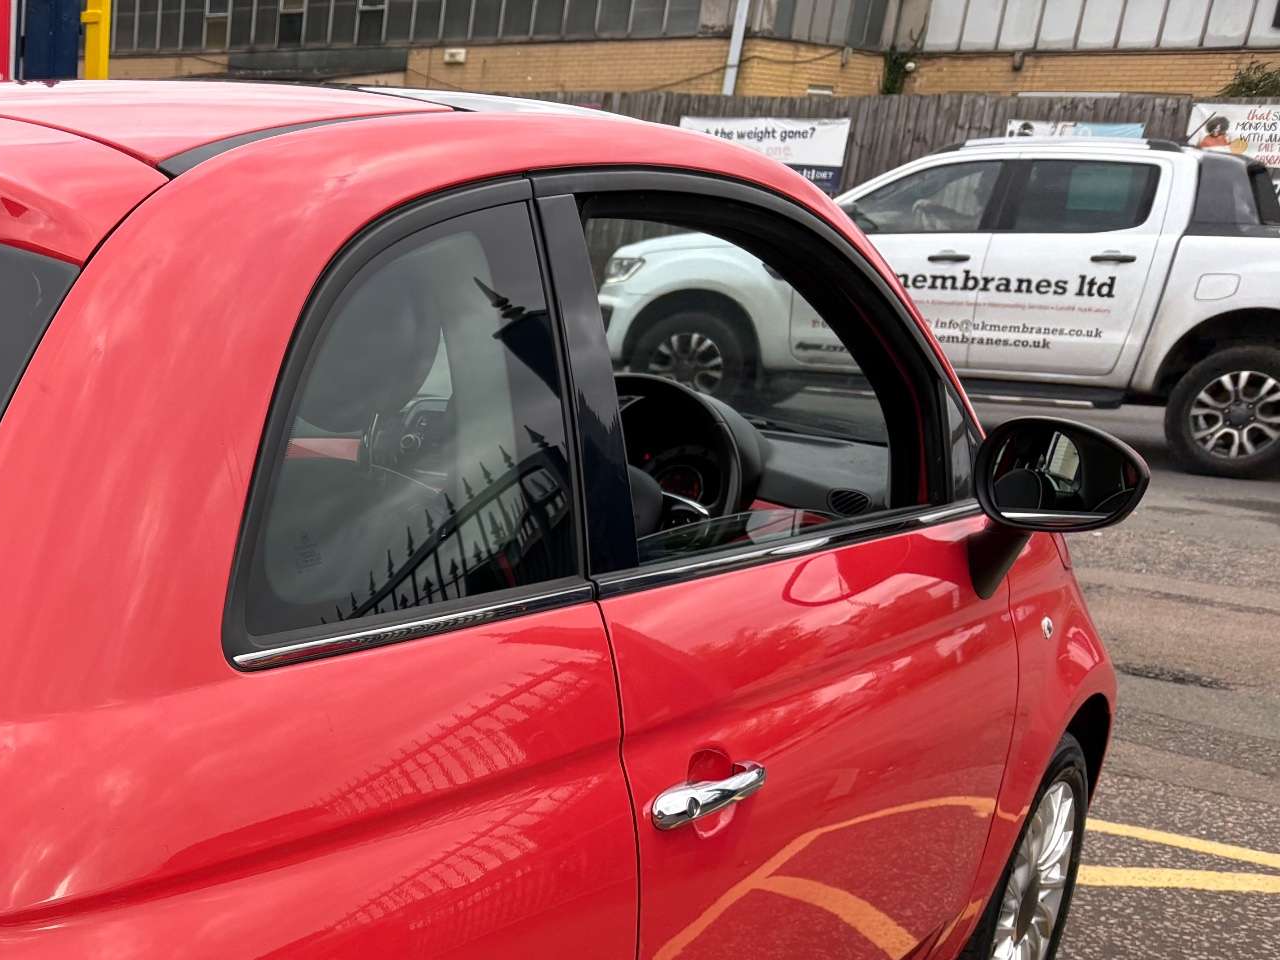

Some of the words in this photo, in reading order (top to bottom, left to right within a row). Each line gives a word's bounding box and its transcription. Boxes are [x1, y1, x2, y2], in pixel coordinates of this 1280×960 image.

[737, 126, 777, 142] weight
[780, 127, 816, 142] gone?
[1075, 274, 1117, 299] ltd
[934, 317, 1104, 339] info@ukmembranes.co.uk
[935, 333, 1052, 350] embranes.co.uk
